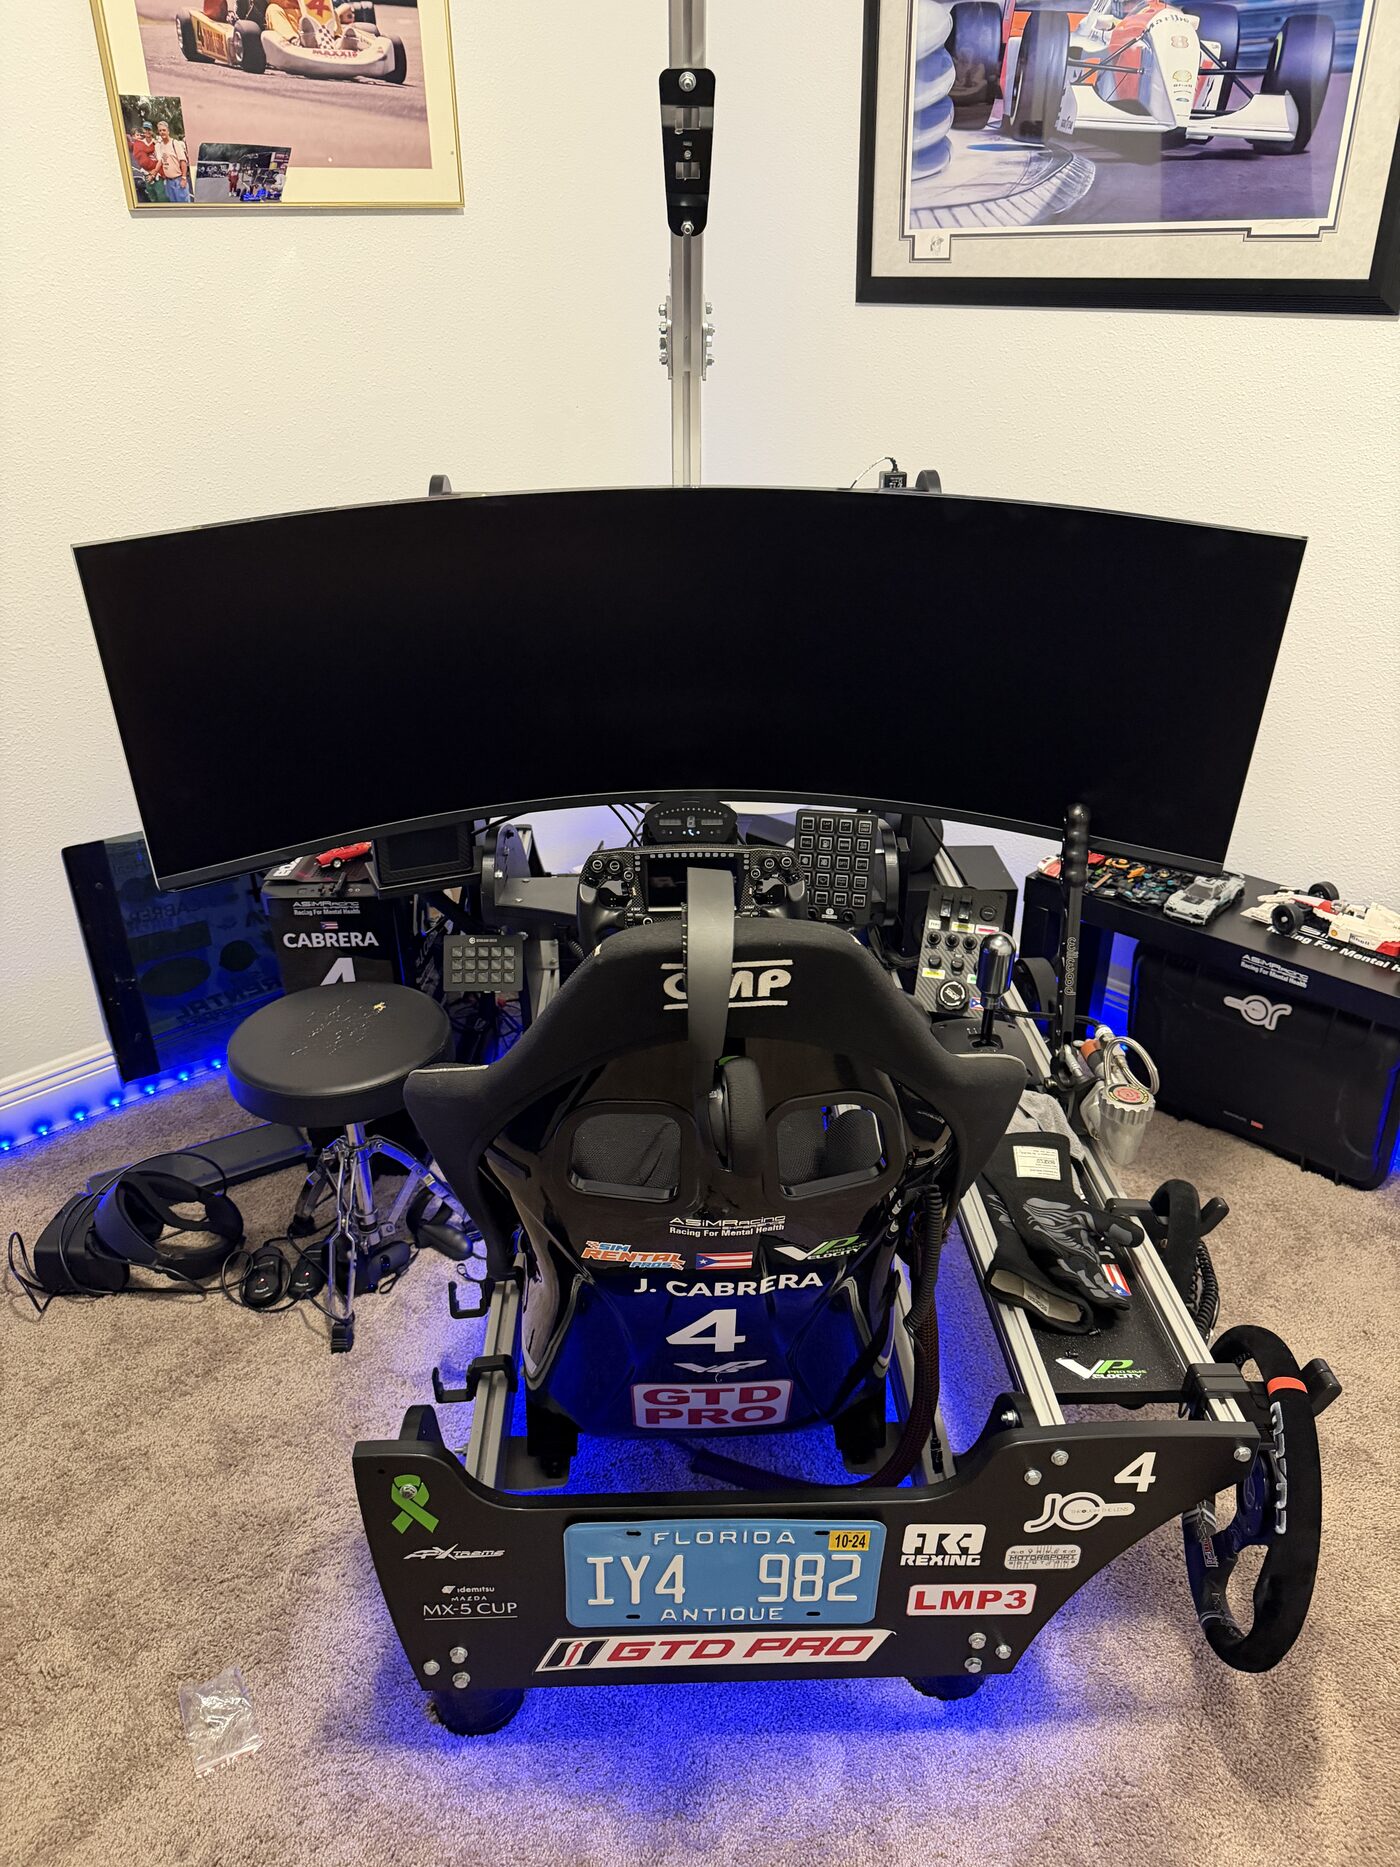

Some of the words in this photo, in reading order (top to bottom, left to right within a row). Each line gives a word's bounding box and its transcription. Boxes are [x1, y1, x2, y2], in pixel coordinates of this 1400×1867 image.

[283, 931, 380, 949] CABRERA
[1266, 926, 1313, 945] Ring
[1313, 938, 1339, 951] For
[1339, 947, 1391, 969] Mental
[1064, 936, 1080, 996] wilwood
[669, 1226, 701, 1238] Racing
[703, 1229, 719, 1237] For
[721, 1228, 754, 1237] Mental
[756, 1224, 785, 1234] Health
[581, 1247, 686, 1265] RENTAL
[599, 1242, 632, 1252] SIM
[629, 1261, 673, 1269] PROS
[634, 1278, 657, 1293] J.
[666, 1272, 824, 1297] CABRERA
[666, 1308, 746, 1353] 4
[642, 1386, 782, 1407] GTD
[645, 1405, 778, 1425] PRO
[1114, 1451, 1157, 1493] 4
[653, 1529, 797, 1546] FLORIDA
[835, 1534, 866, 1549] 10-24
[900, 1554, 981, 1566] REXING
[586, 1554, 686, 1606] IY4
[757, 1553, 862, 1604] 982
[423, 1603, 472, 1616] MX-5
[476, 1602, 518, 1615] CUP
[914, 1589, 1028, 1611] LMP3
[660, 1607, 785, 1623] ANTIQUE
[606, 1639, 736, 1663] GTD
[742, 1635, 875, 1660] PRO
